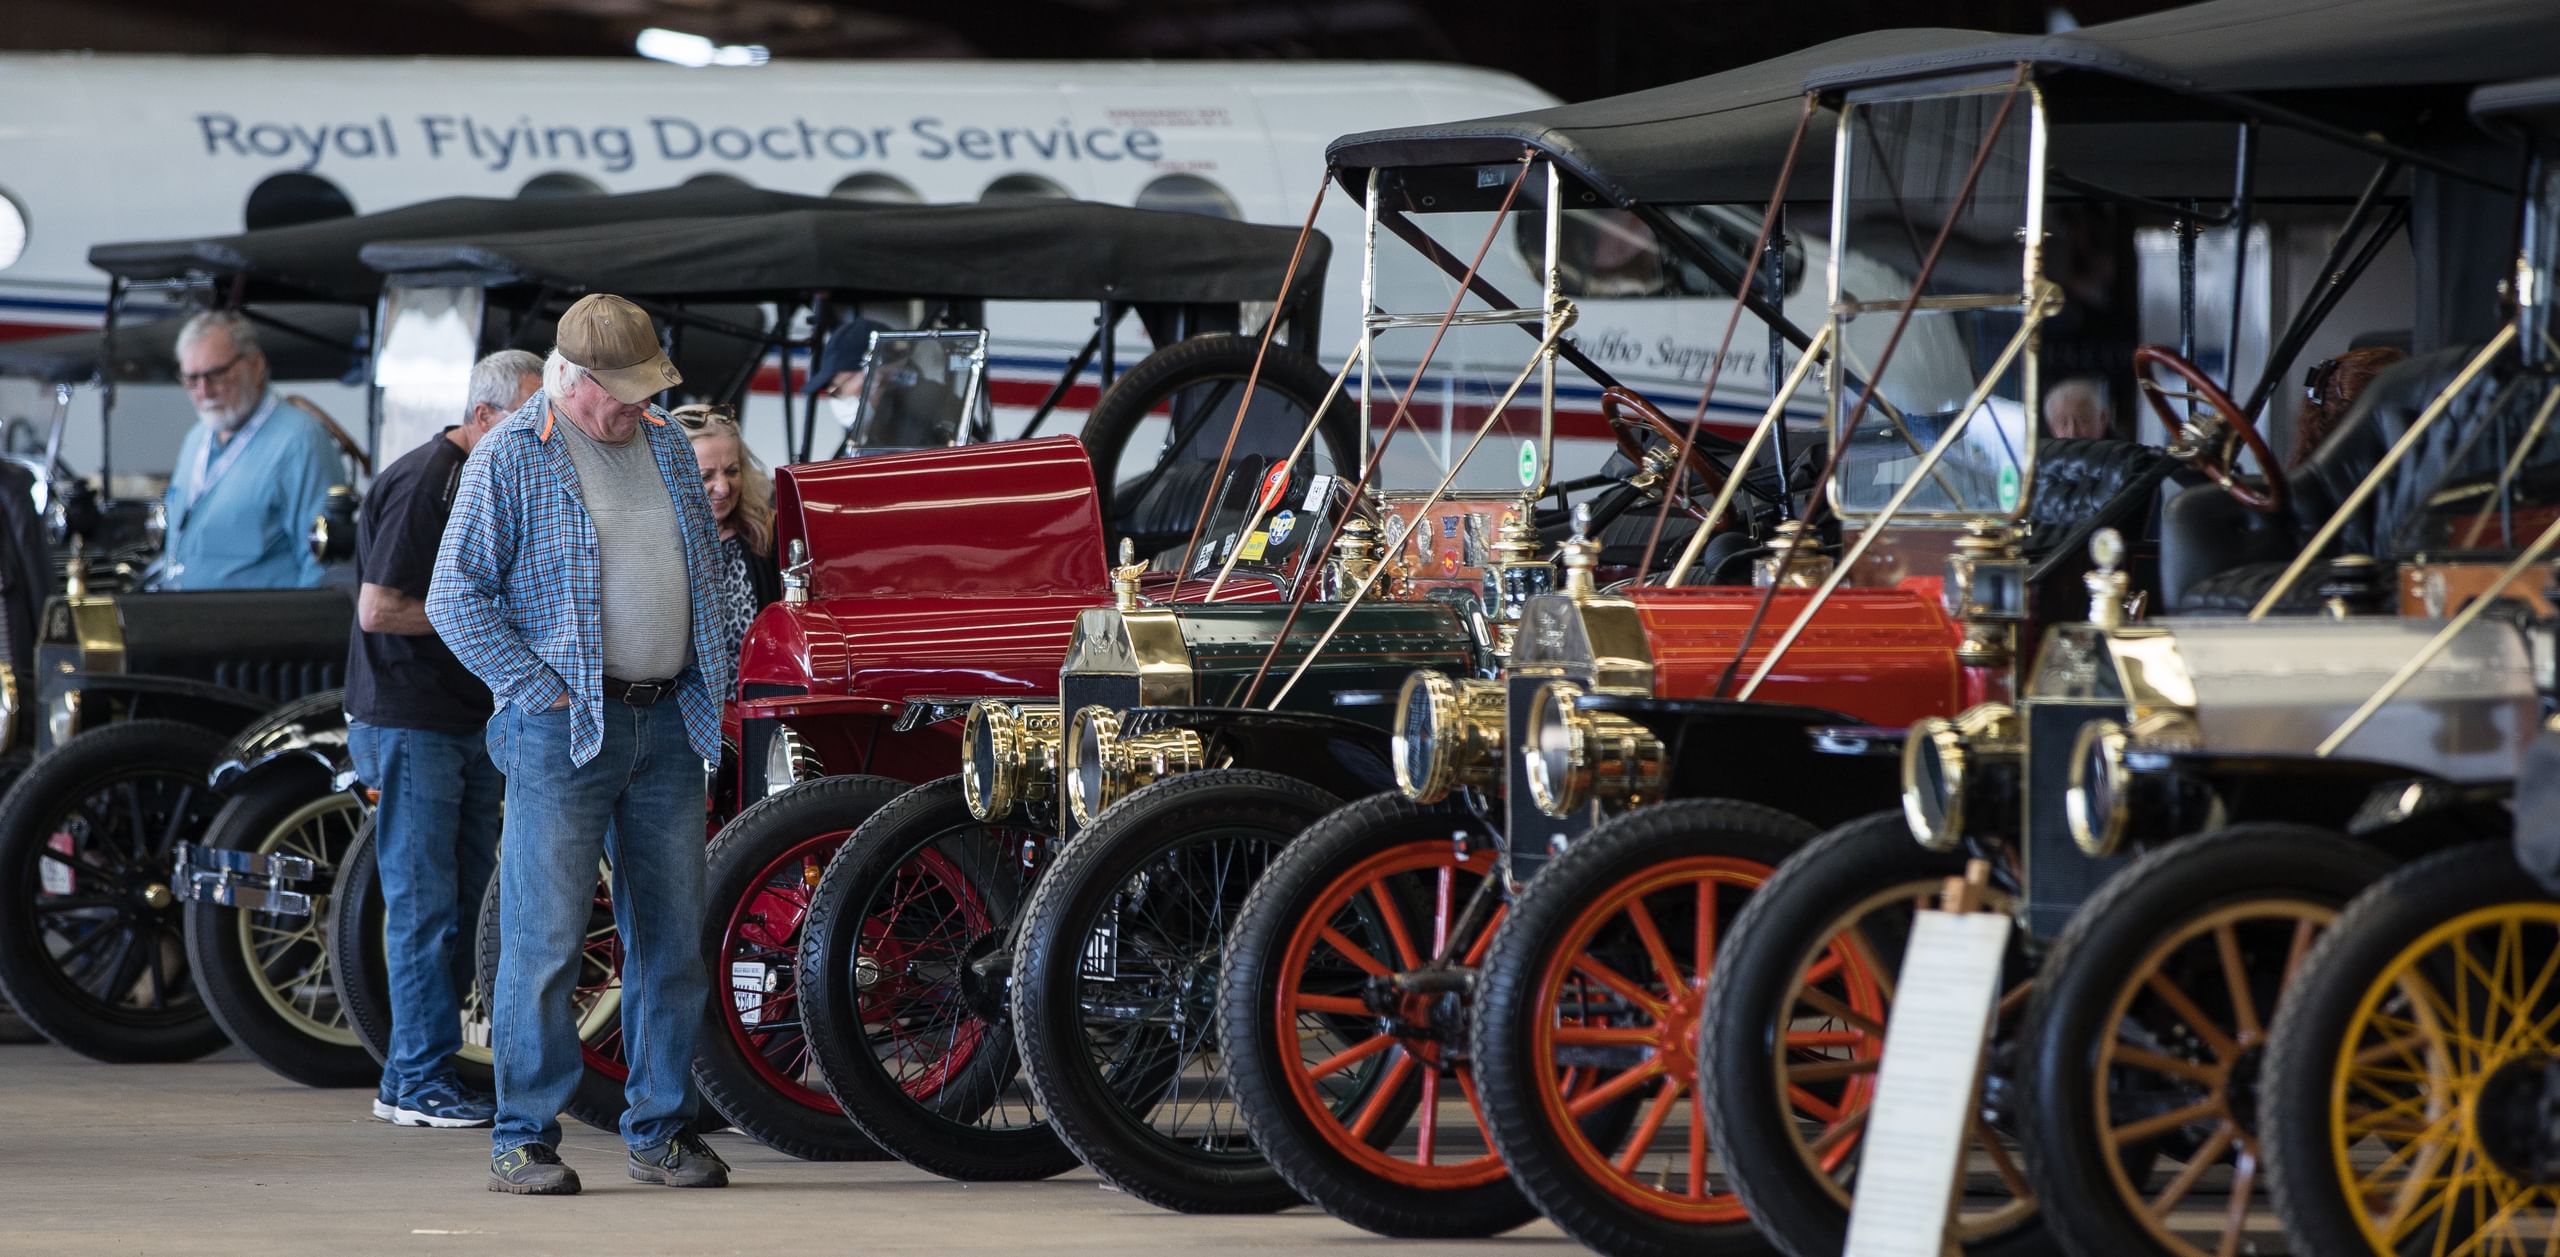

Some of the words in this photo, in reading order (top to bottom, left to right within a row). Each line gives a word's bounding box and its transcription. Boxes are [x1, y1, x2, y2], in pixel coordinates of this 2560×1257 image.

[195, 112, 399, 173] Royal
[418, 114, 637, 174] Flying
[647, 116, 896, 162] Doctor
[909, 116, 1164, 162] Service
